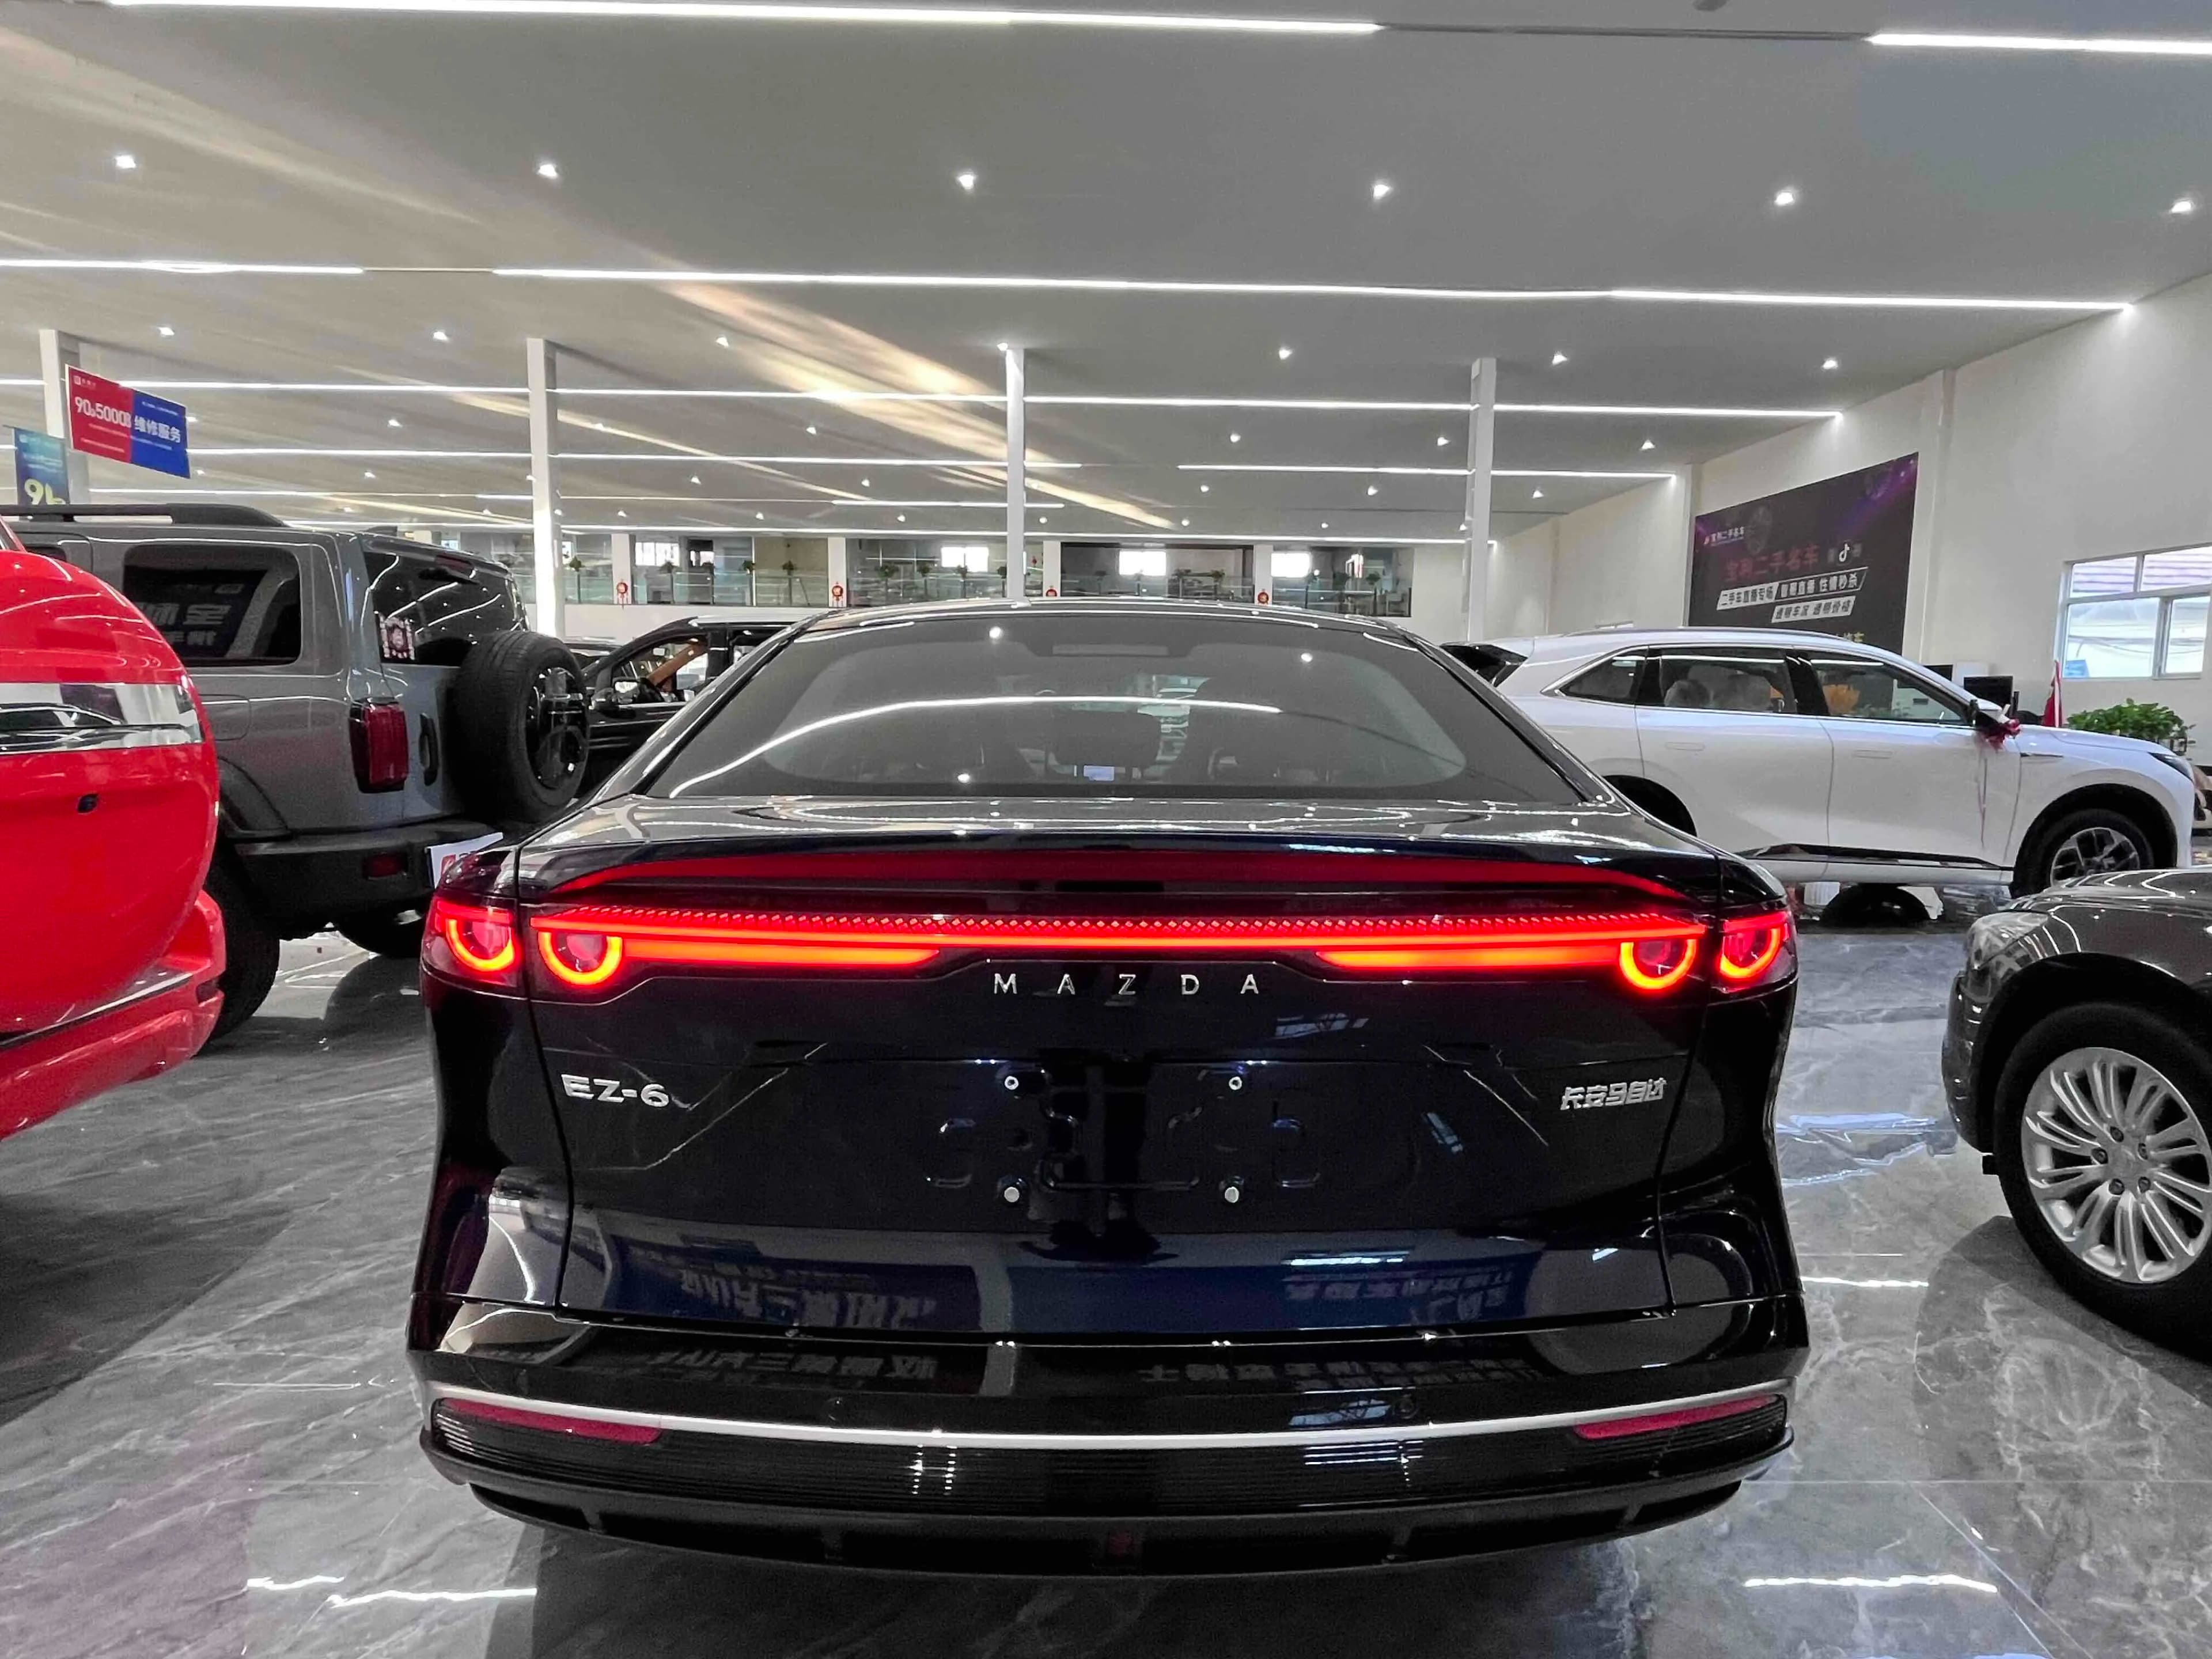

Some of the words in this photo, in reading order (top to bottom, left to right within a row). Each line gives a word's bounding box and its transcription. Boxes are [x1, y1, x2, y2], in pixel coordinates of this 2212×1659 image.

[993, 973, 1259, 995] MAZDA
[560, 1073, 670, 1108] EZ-6
[1559, 1077, 1667, 1111] 长安马自达
